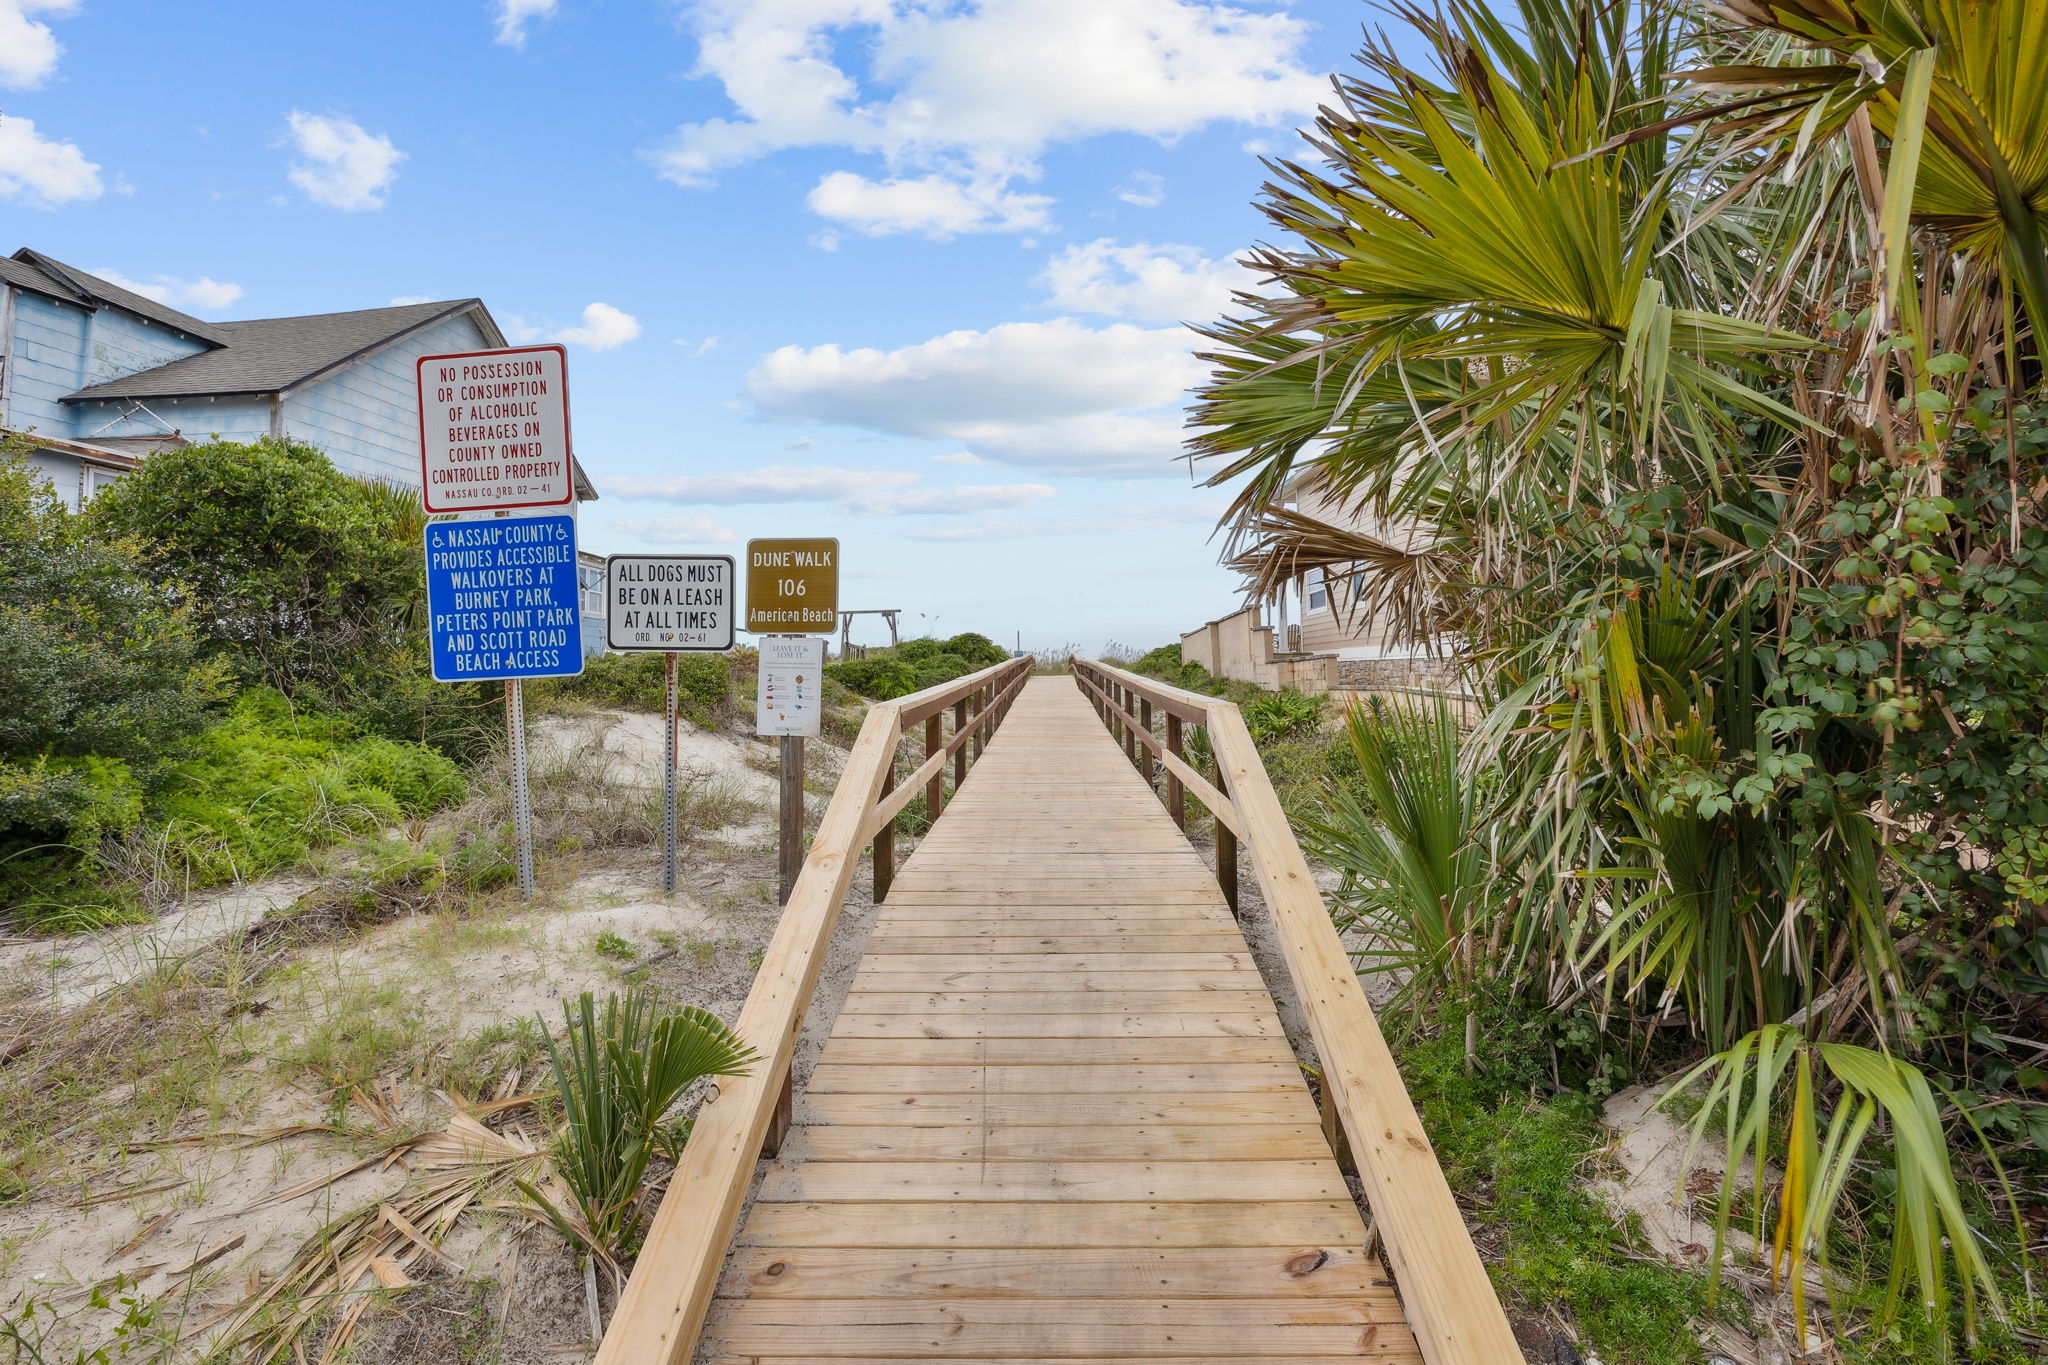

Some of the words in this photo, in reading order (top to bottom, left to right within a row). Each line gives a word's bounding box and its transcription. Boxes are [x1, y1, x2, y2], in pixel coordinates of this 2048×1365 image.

[440, 367, 456, 382] NO
[464, 361, 542, 380] POSSESSION
[438, 388, 453, 402] OR
[462, 381, 547, 400] CONSUMPTION
[449, 407, 463, 421] OF
[471, 402, 537, 420] ALCOHOLIC
[449, 424, 517, 442] BEVERAGES
[525, 422, 540, 436] ON
[449, 446, 495, 462] COUNTY
[502, 443, 542, 459] OWNED
[433, 466, 499, 484] CONTROLLED
[506, 462, 560, 479] PROPERTY
[446, 488, 478, 499] NASSAU
[482, 488, 493, 496] CO.
[449, 528, 498, 547] NASSAU
[506, 524, 553, 543] COUNTY
[433, 549, 492, 569] PROVIDES
[498, 545, 570, 566] ACCESSIBLE
[754, 552, 790, 567] DUNE
[795, 552, 831, 566] WALK
[451, 569, 532, 589] WALKOVERS
[539, 567, 554, 584] AT
[619, 565, 643, 582] ALL
[649, 565, 682, 582] DOGS
[688, 565, 722, 582] MUST
[619, 588, 635, 605] BE
[641, 588, 659, 605] ON
[664, 589, 672, 605] A
[678, 589, 722, 605] LEASH
[778, 579, 806, 596] 106
[455, 590, 509, 610] BURNEY
[516, 588, 557, 607] PARK,
[437, 612, 488, 632] PETERS
[493, 610, 532, 629] POINT
[538, 608, 573, 626] PARK
[624, 611, 640, 628] AT
[646, 612, 672, 628] ALL
[676, 612, 717, 629] TIMES
[751, 608, 799, 622] American
[803, 608, 833, 622] Beach
[448, 634, 474, 652] AND
[480, 631, 523, 650] SCOTT
[530, 629, 566, 648] ROAD
[456, 653, 500, 671] BEACH
[509, 650, 559, 669] ACCESS
